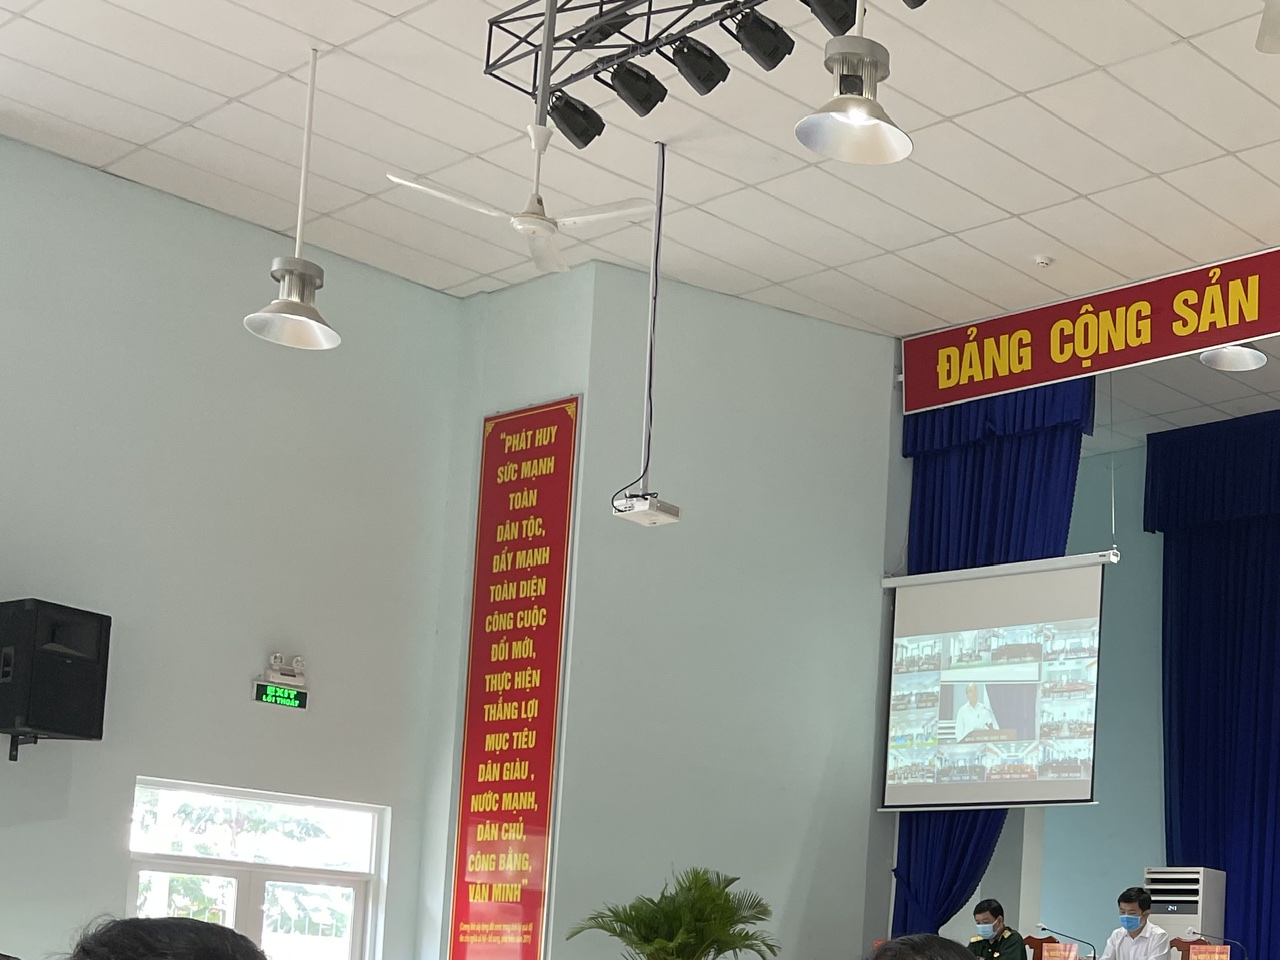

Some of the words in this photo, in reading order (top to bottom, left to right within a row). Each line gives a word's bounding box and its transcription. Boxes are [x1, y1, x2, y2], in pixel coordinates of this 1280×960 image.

[937, 326, 1032, 390] ĐẢNG
[1050, 302, 1151, 368] CỘNG
[1172, 266, 1259, 338] SẢN
[535, 425, 558, 447] HUY
[497, 462, 518, 484] SỨC
[521, 456, 555, 481] MẠNH
[509, 487, 537, 511] TOÀN
[496, 519, 519, 543] DÂN
[522, 515, 546, 541] TỘC,
[492, 545, 514, 573] ĐẨY
[515, 546, 550, 572] MẠNH
[489, 579, 517, 603] TOÀN
[519, 575, 546, 601] DIỆN
[485, 611, 514, 633] CÔNG
[516, 607, 547, 631] CUỘC
[491, 636, 509, 662] ĐỔI
[512, 636, 536, 659] MỚI,
[267, 685, 297, 699] EXIT
[484, 671, 512, 695] THỰC
[514, 666, 541, 693] HIỆN
[483, 697, 518, 722] THẮNG
[521, 699, 539, 723] LỢI
[484, 733, 509, 755] MỤC
[512, 728, 537, 750] TIÊU
[477, 760, 499, 783] DÂN
[470, 791, 500, 813] NƯỚC
[501, 791, 538, 815] MẠNH,
[476, 820, 499, 842] DÂN
[501, 817, 527, 842] CHỦ,
[468, 851, 496, 872] CÔNG
[499, 848, 532, 873] BẰNG,
[468, 880, 489, 902] VĂN
